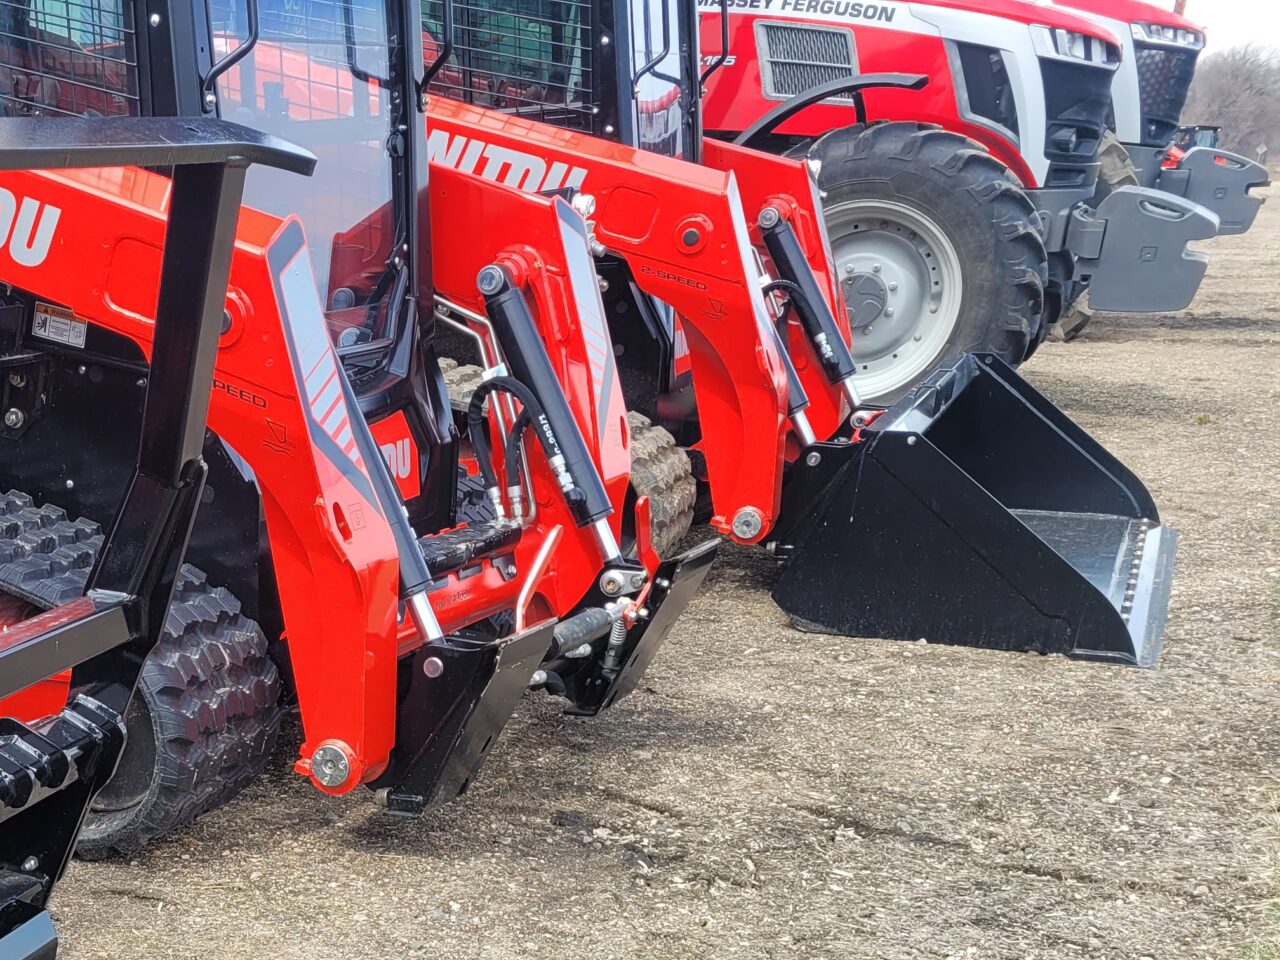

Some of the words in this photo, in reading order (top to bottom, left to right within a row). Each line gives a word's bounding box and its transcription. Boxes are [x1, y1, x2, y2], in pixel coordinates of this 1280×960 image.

[780, 0, 896, 22] FERGUSON
[426, 128, 589, 192] NITOU
[641, 265, 707, 291] 2-SPEED
[212, 379, 267, 409] PEED
